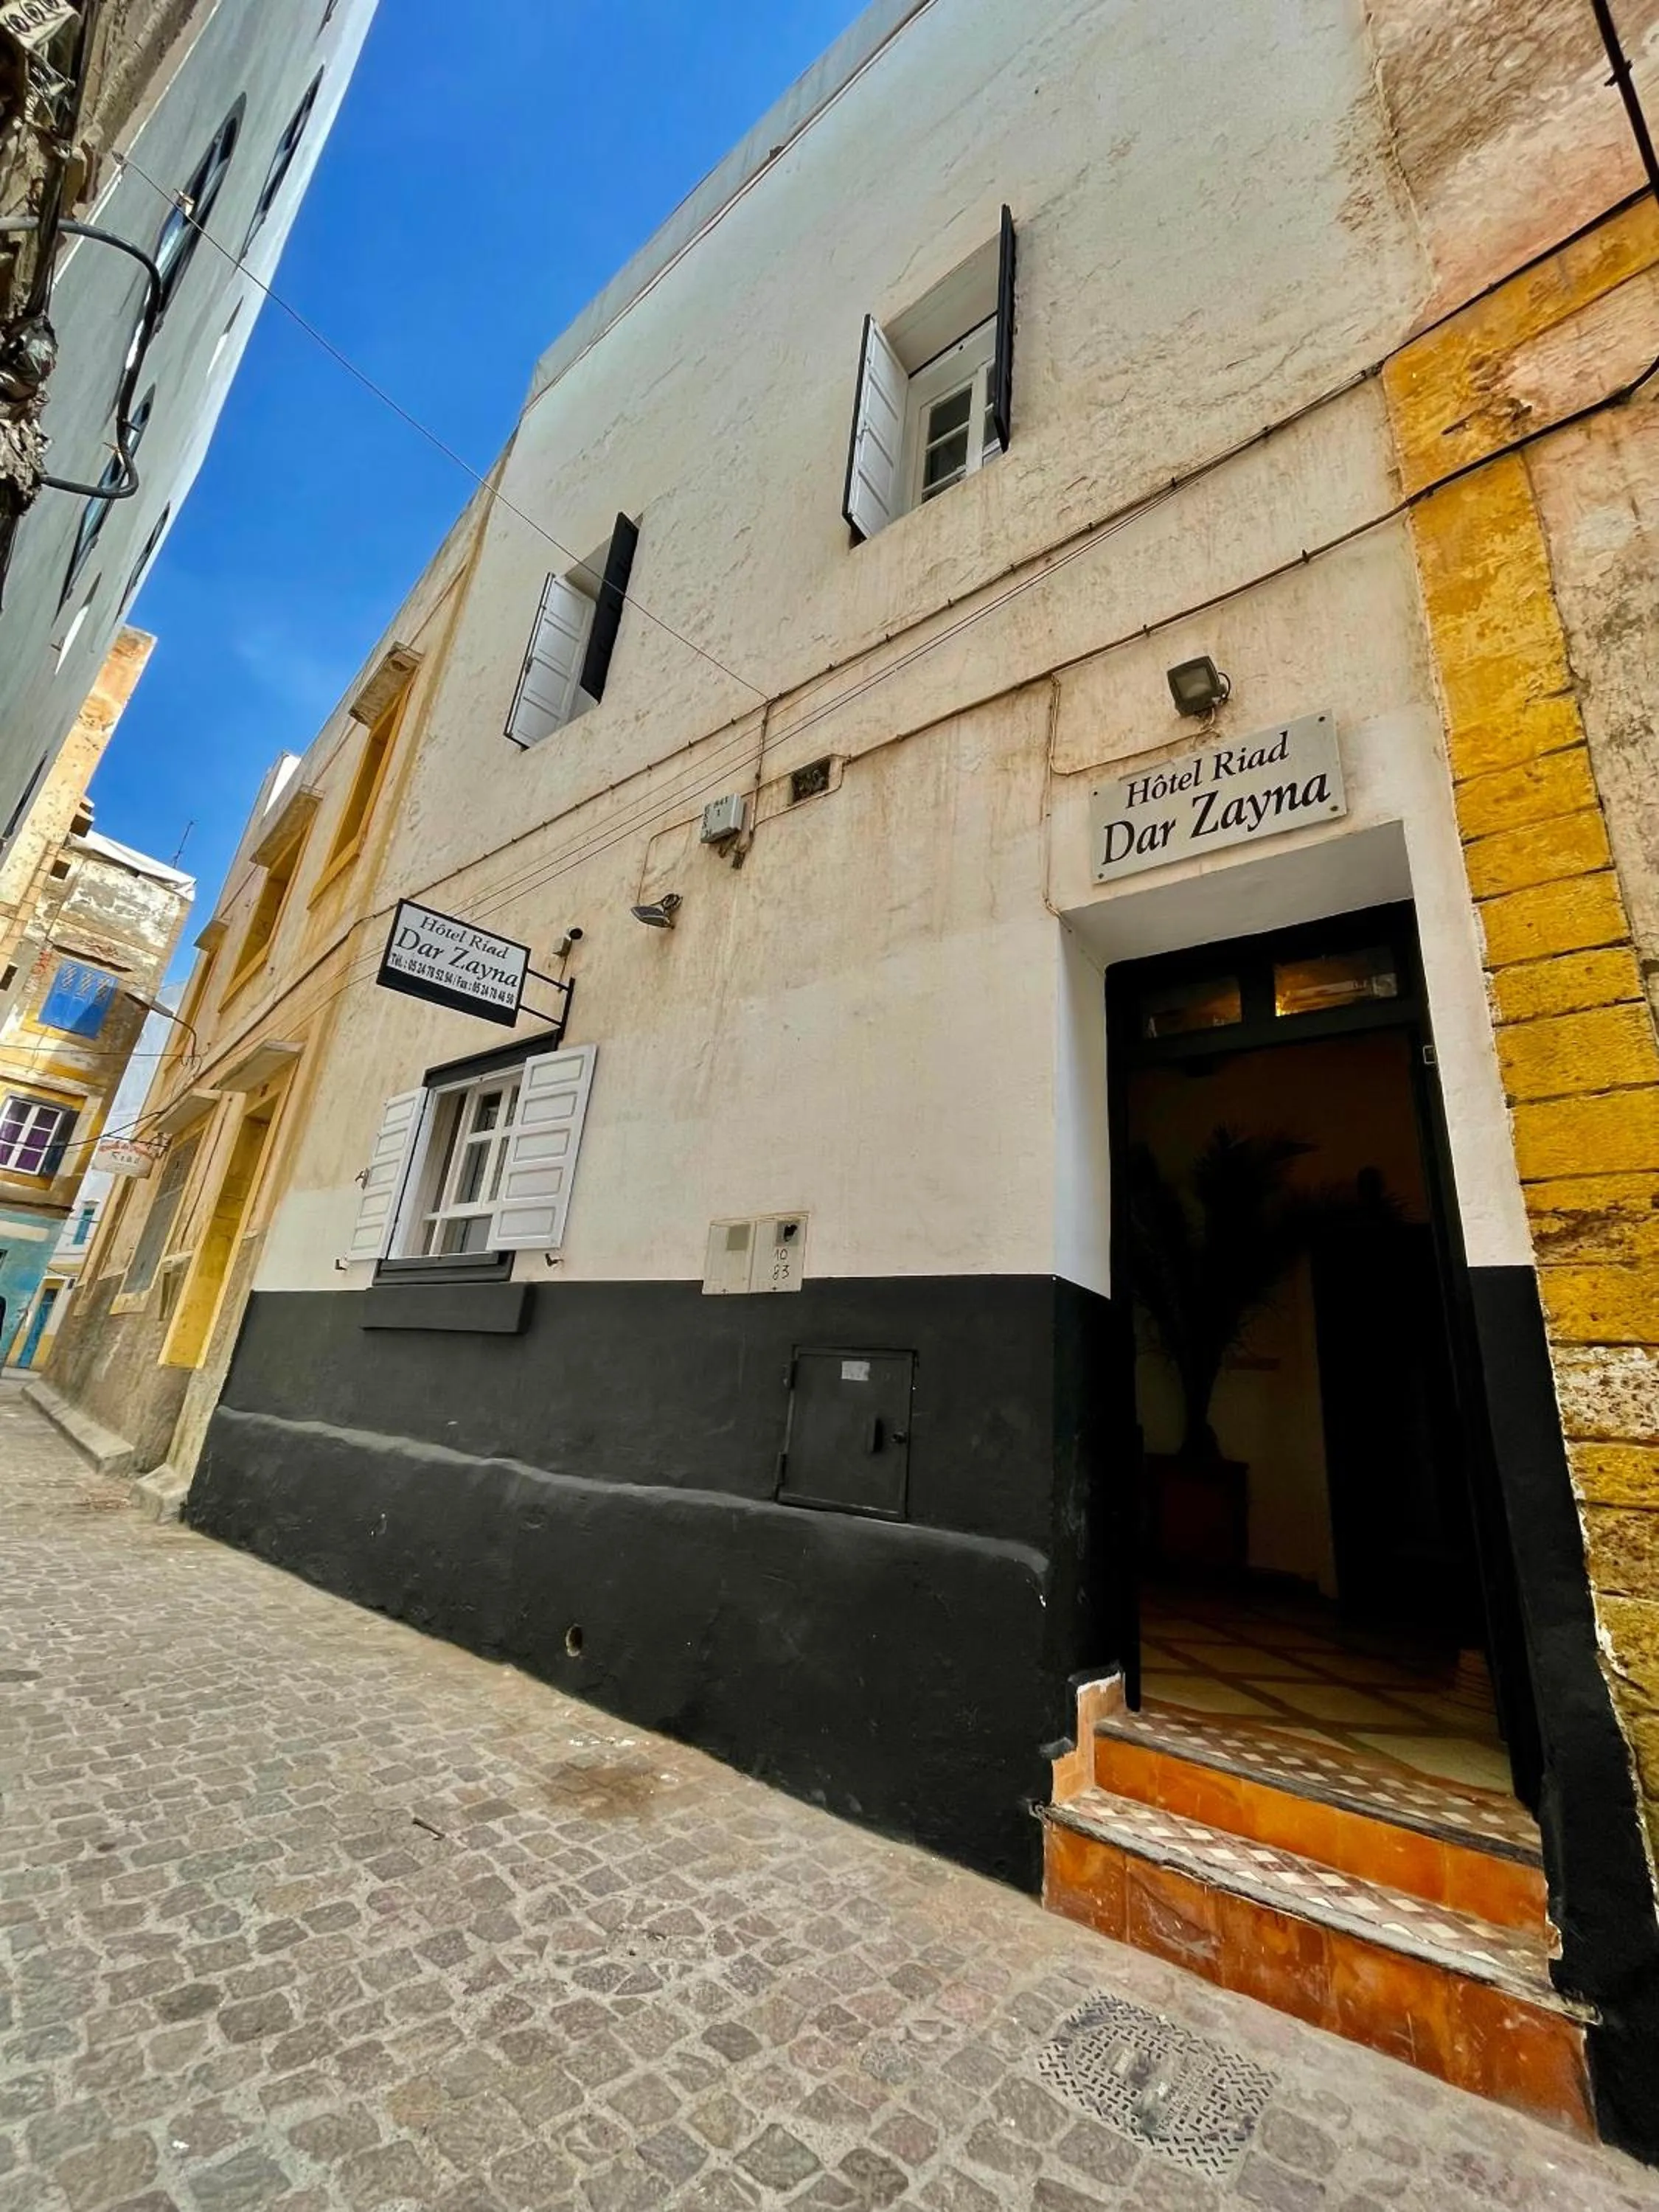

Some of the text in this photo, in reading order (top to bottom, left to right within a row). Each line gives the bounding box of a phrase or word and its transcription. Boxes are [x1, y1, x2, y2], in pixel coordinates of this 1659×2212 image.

[1125, 730, 1289, 809] Hôtel Riad
[1102, 773, 1331, 866] Dar Zayna
[395, 927, 518, 987] Dar Zayna
[420, 917, 509, 959] Hôtel Riad
